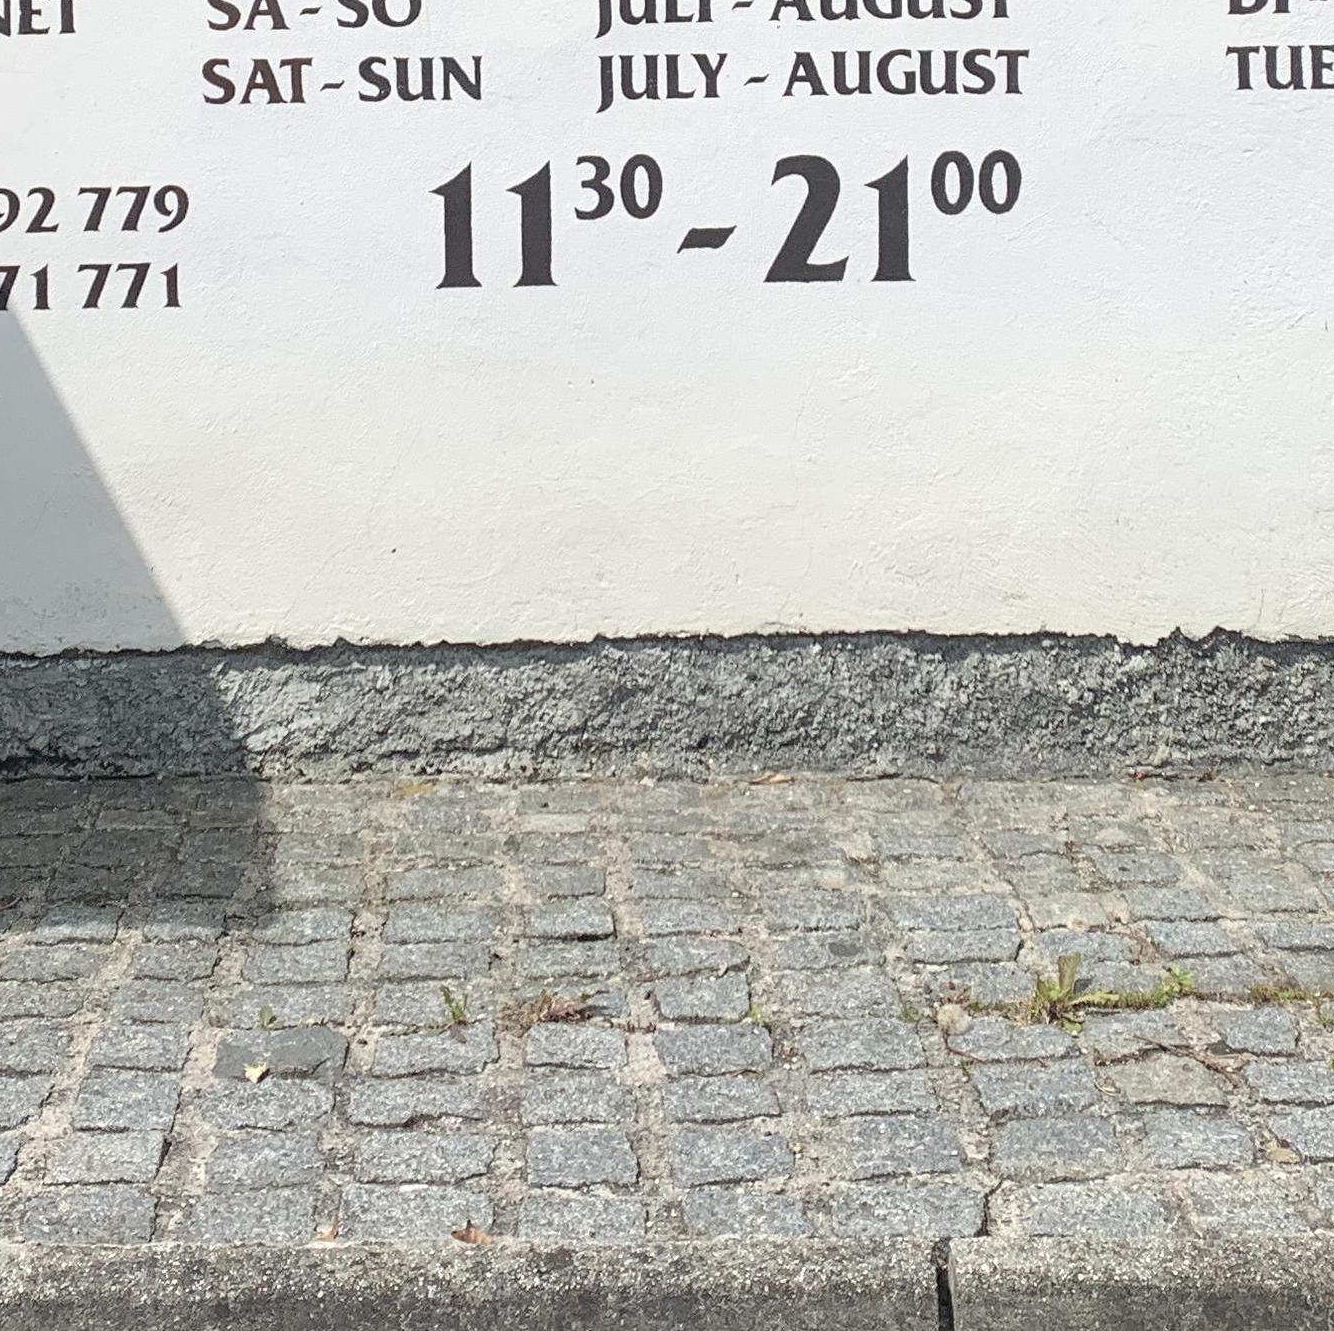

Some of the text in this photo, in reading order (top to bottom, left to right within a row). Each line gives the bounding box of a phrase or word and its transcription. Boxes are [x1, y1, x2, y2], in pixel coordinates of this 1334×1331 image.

[200, 56, 314, 106] SAT
[357, 54, 484, 104] SUN
[594, 51, 729, 115] JULY
[780, 47, 1031, 98] AUGUST
[76, 183, 191, 234] 779
[76, 261, 182, 311] 771
